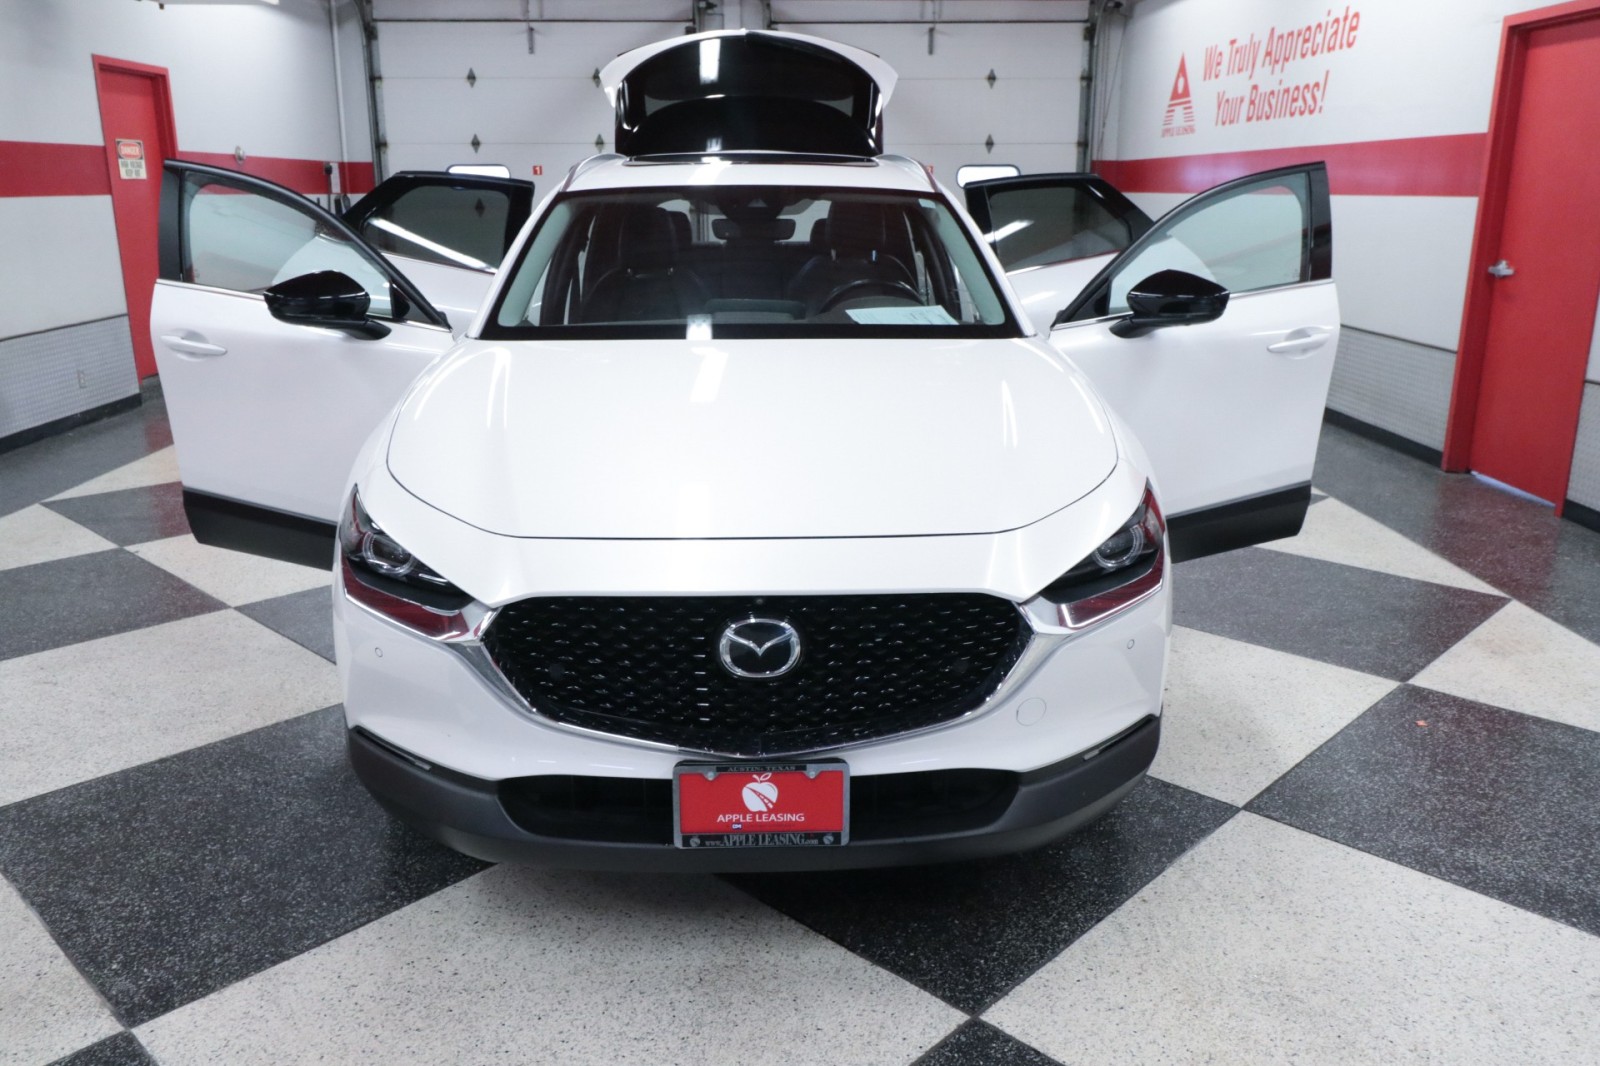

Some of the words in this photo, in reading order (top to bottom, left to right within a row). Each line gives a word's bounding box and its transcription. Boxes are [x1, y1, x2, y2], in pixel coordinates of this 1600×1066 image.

[1203, 45, 1223, 82] We
[1227, 33, 1262, 80] Truly
[1262, 6, 1360, 75] Appreciate
[1215, 91, 1245, 127] Your
[1246, 70, 1330, 123] Business!
[717, 813, 752, 823] APPLE
[755, 812, 805, 822] LEASING
